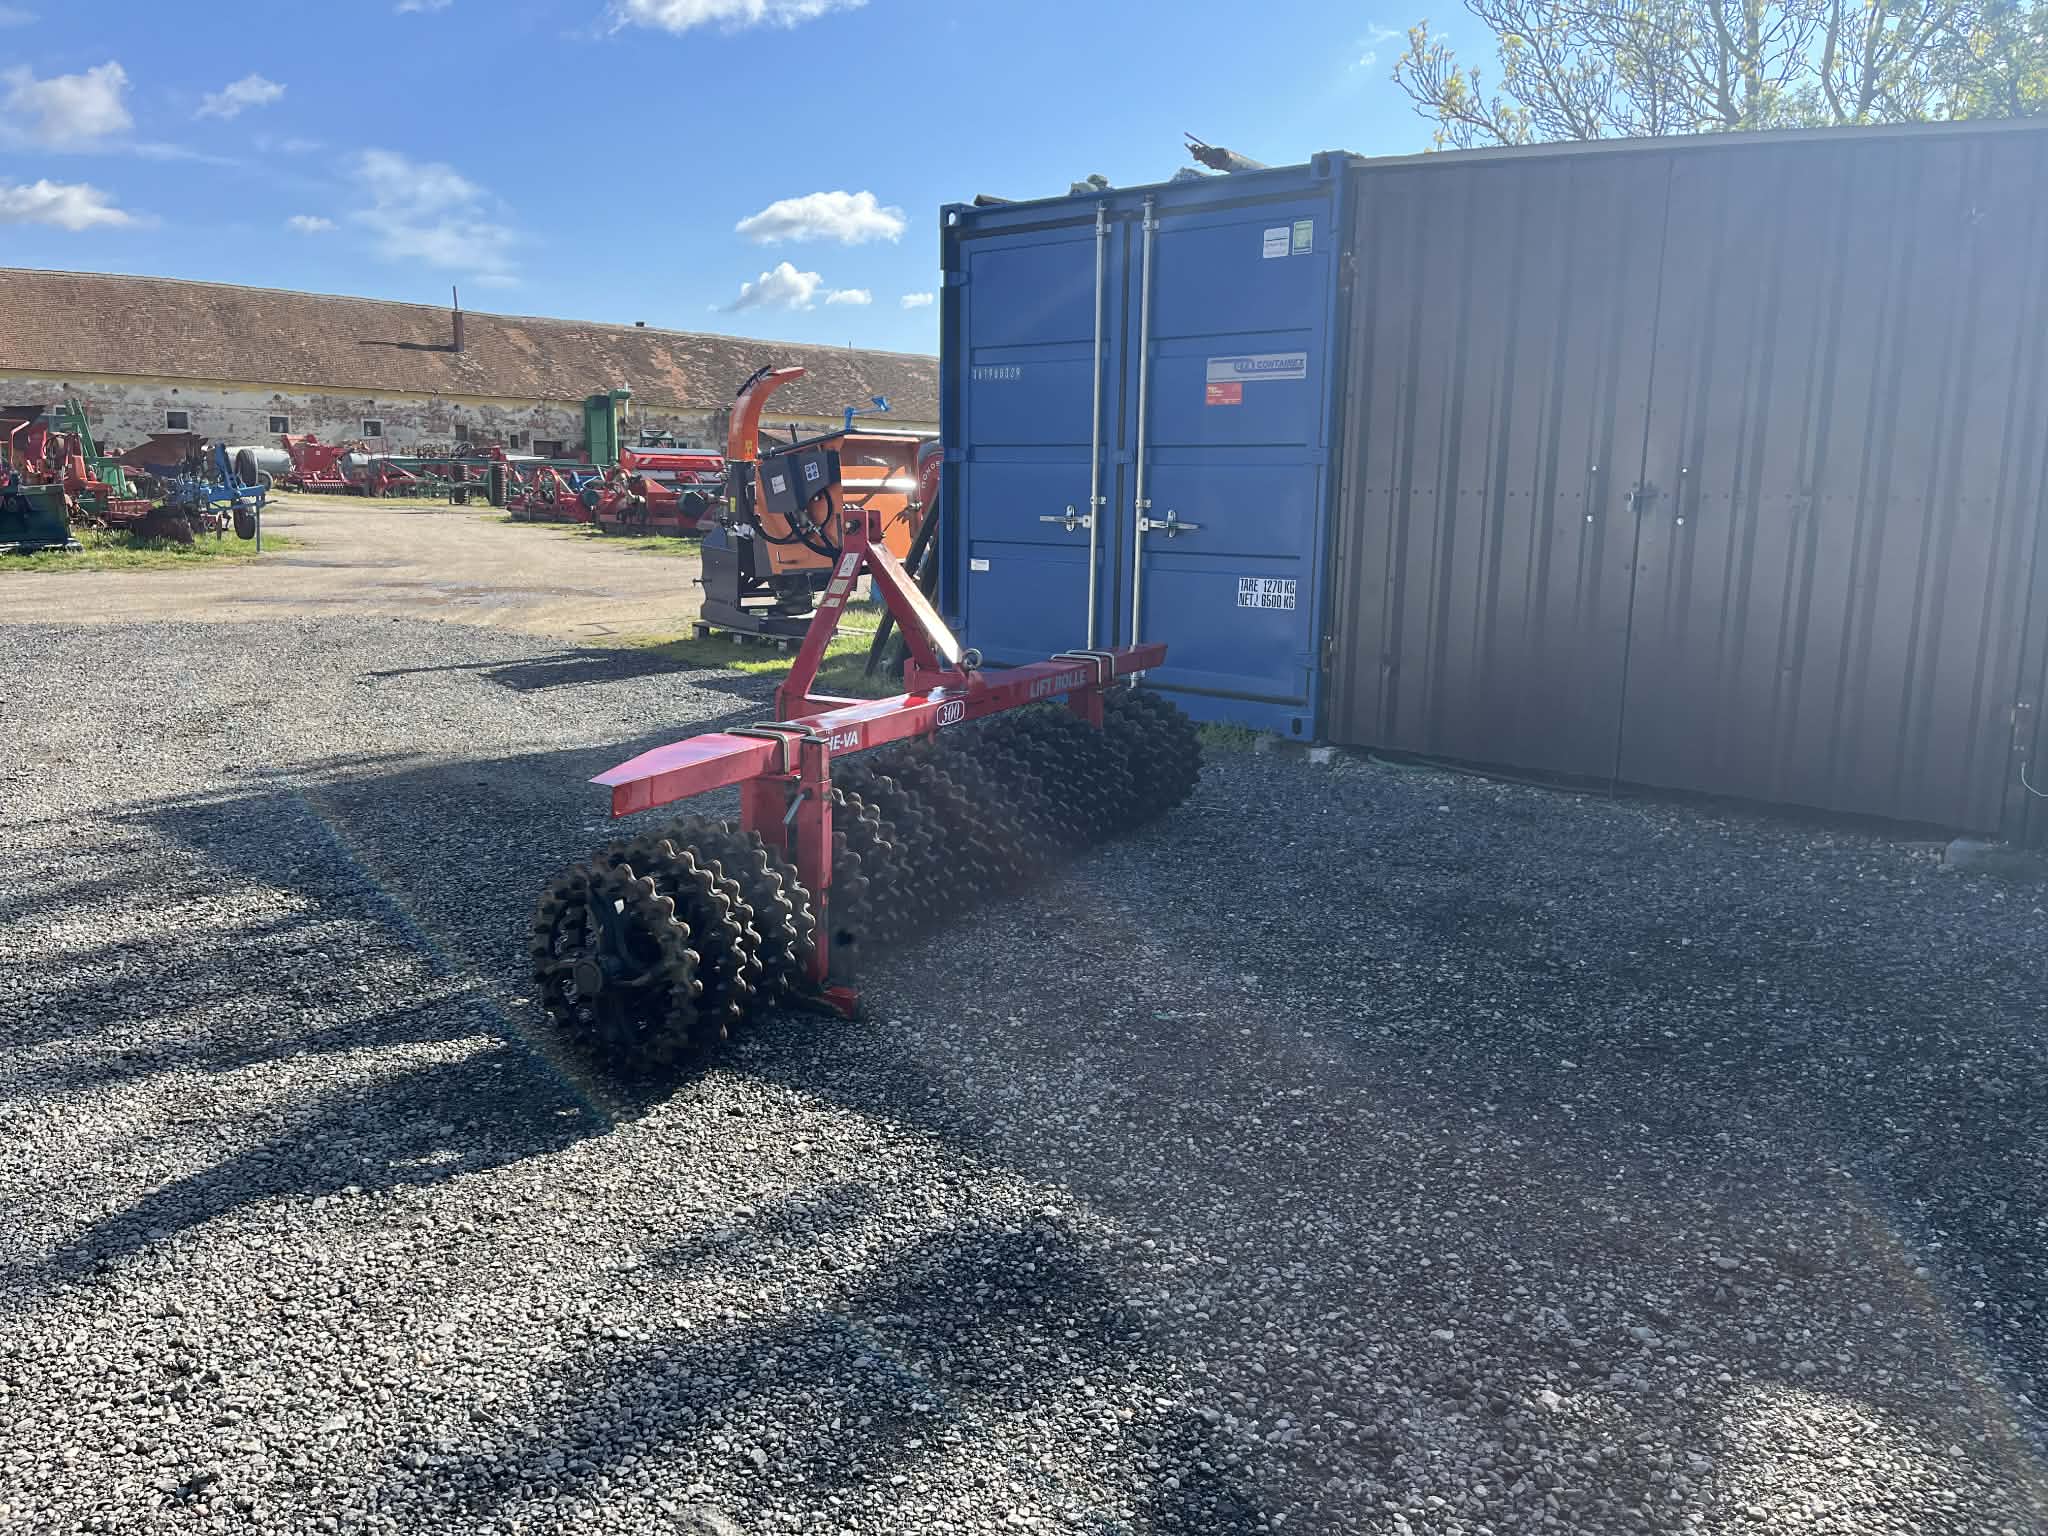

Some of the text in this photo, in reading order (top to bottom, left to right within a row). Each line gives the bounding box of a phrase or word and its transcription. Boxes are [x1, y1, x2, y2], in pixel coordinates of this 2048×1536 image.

[1240, 578, 1295, 594] TARE 1270 KG
[1262, 594, 1281, 608] 6500
[1284, 595, 1294, 609] KG
[942, 703, 960, 724] 300
